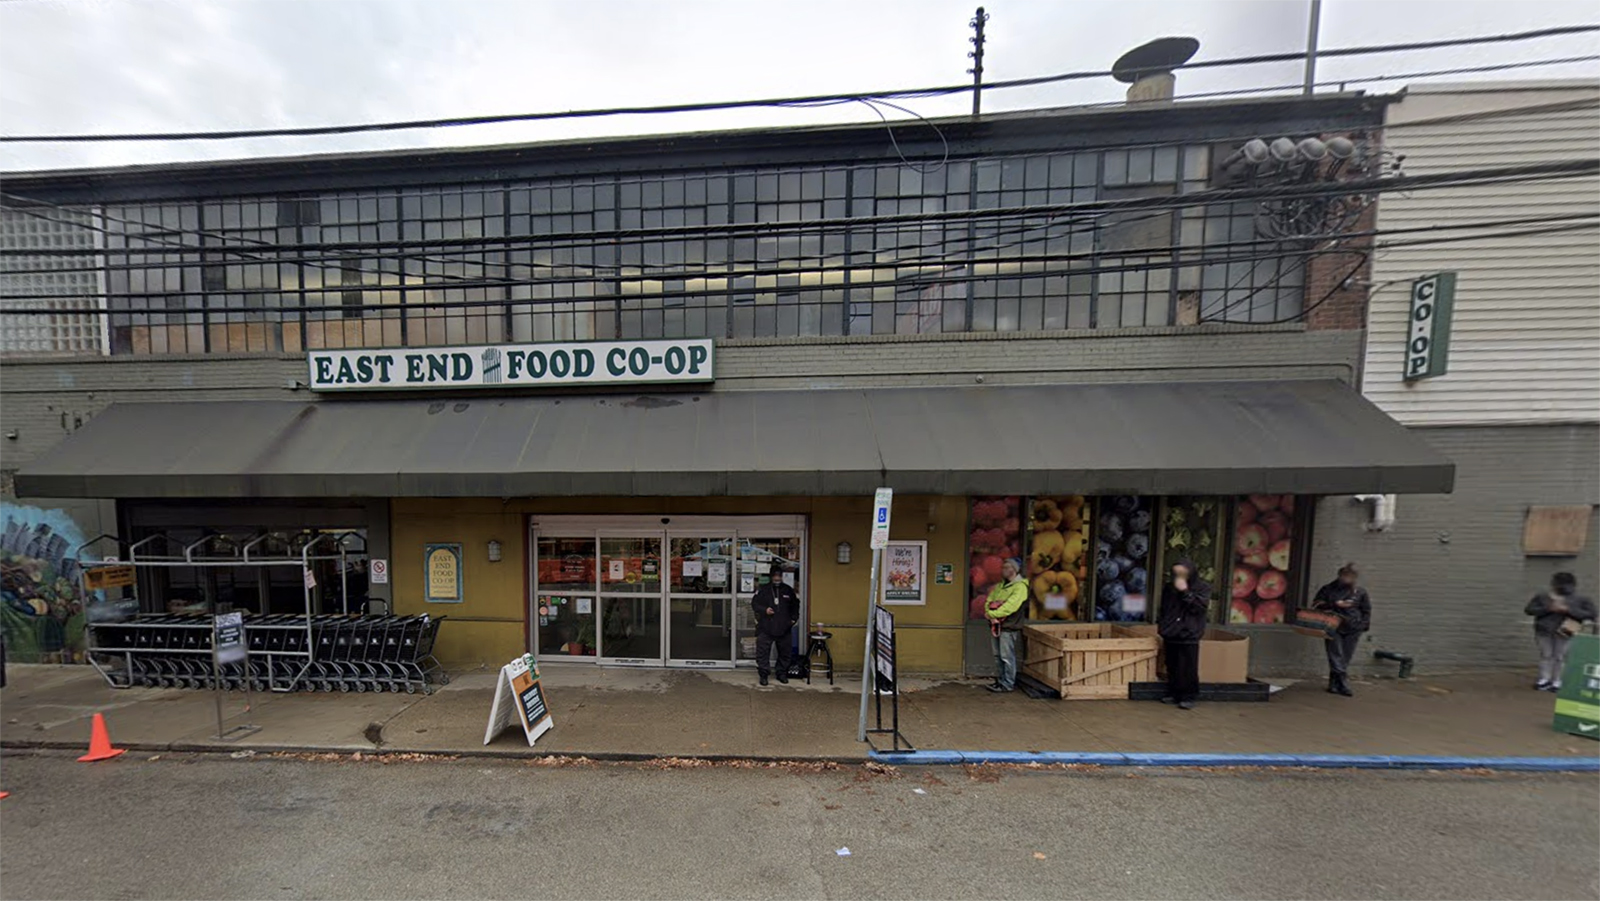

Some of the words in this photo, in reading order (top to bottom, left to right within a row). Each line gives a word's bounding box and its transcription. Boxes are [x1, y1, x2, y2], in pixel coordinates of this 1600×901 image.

[314, 355, 394, 384] EAST
[405, 352, 473, 382] END
[507, 349, 595, 379] FOOD
[606, 345, 708, 376] CO-OP
[895, 547, 912, 557] We're
[891, 557, 915, 568] Hiring!
